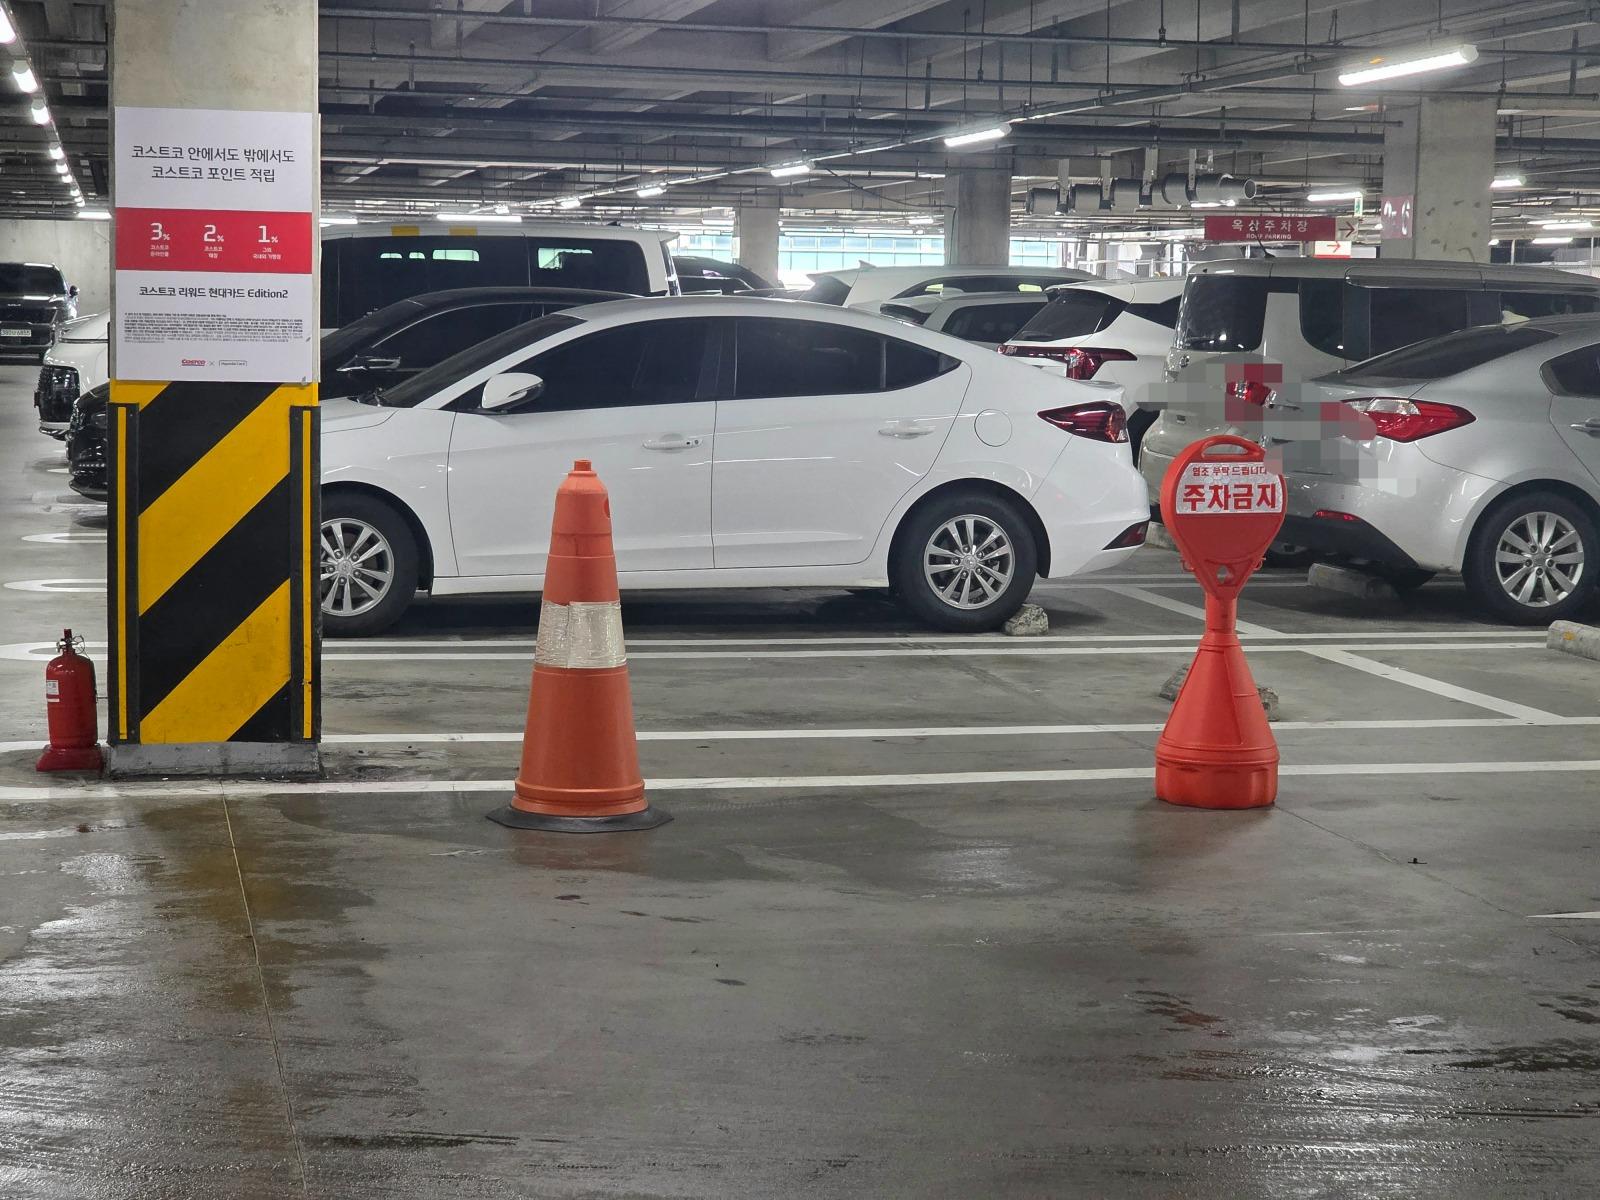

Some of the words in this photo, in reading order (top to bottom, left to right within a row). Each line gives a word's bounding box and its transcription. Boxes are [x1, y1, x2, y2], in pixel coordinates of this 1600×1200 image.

[132, 145, 184, 159] 코스트코
[188, 147, 240, 162] 안에서도
[244, 148, 295, 163] 밖에서도
[151, 166, 203, 179] 코스트코
[207, 167, 246, 182] 포인트
[250, 168, 275, 183] 적립
[150, 222, 170, 241] 3%
[203, 224, 225, 243] 2%
[258, 225, 279, 244] 1%
[1231, 219, 1308, 232] 옥상주차장
[139, 286, 176, 296] 코스트코
[178, 287, 206, 298] 리워드
[209, 287, 245, 298] 현대카드
[247, 288, 289, 299] Edition2
[1183, 483, 1276, 511] 주차금지
